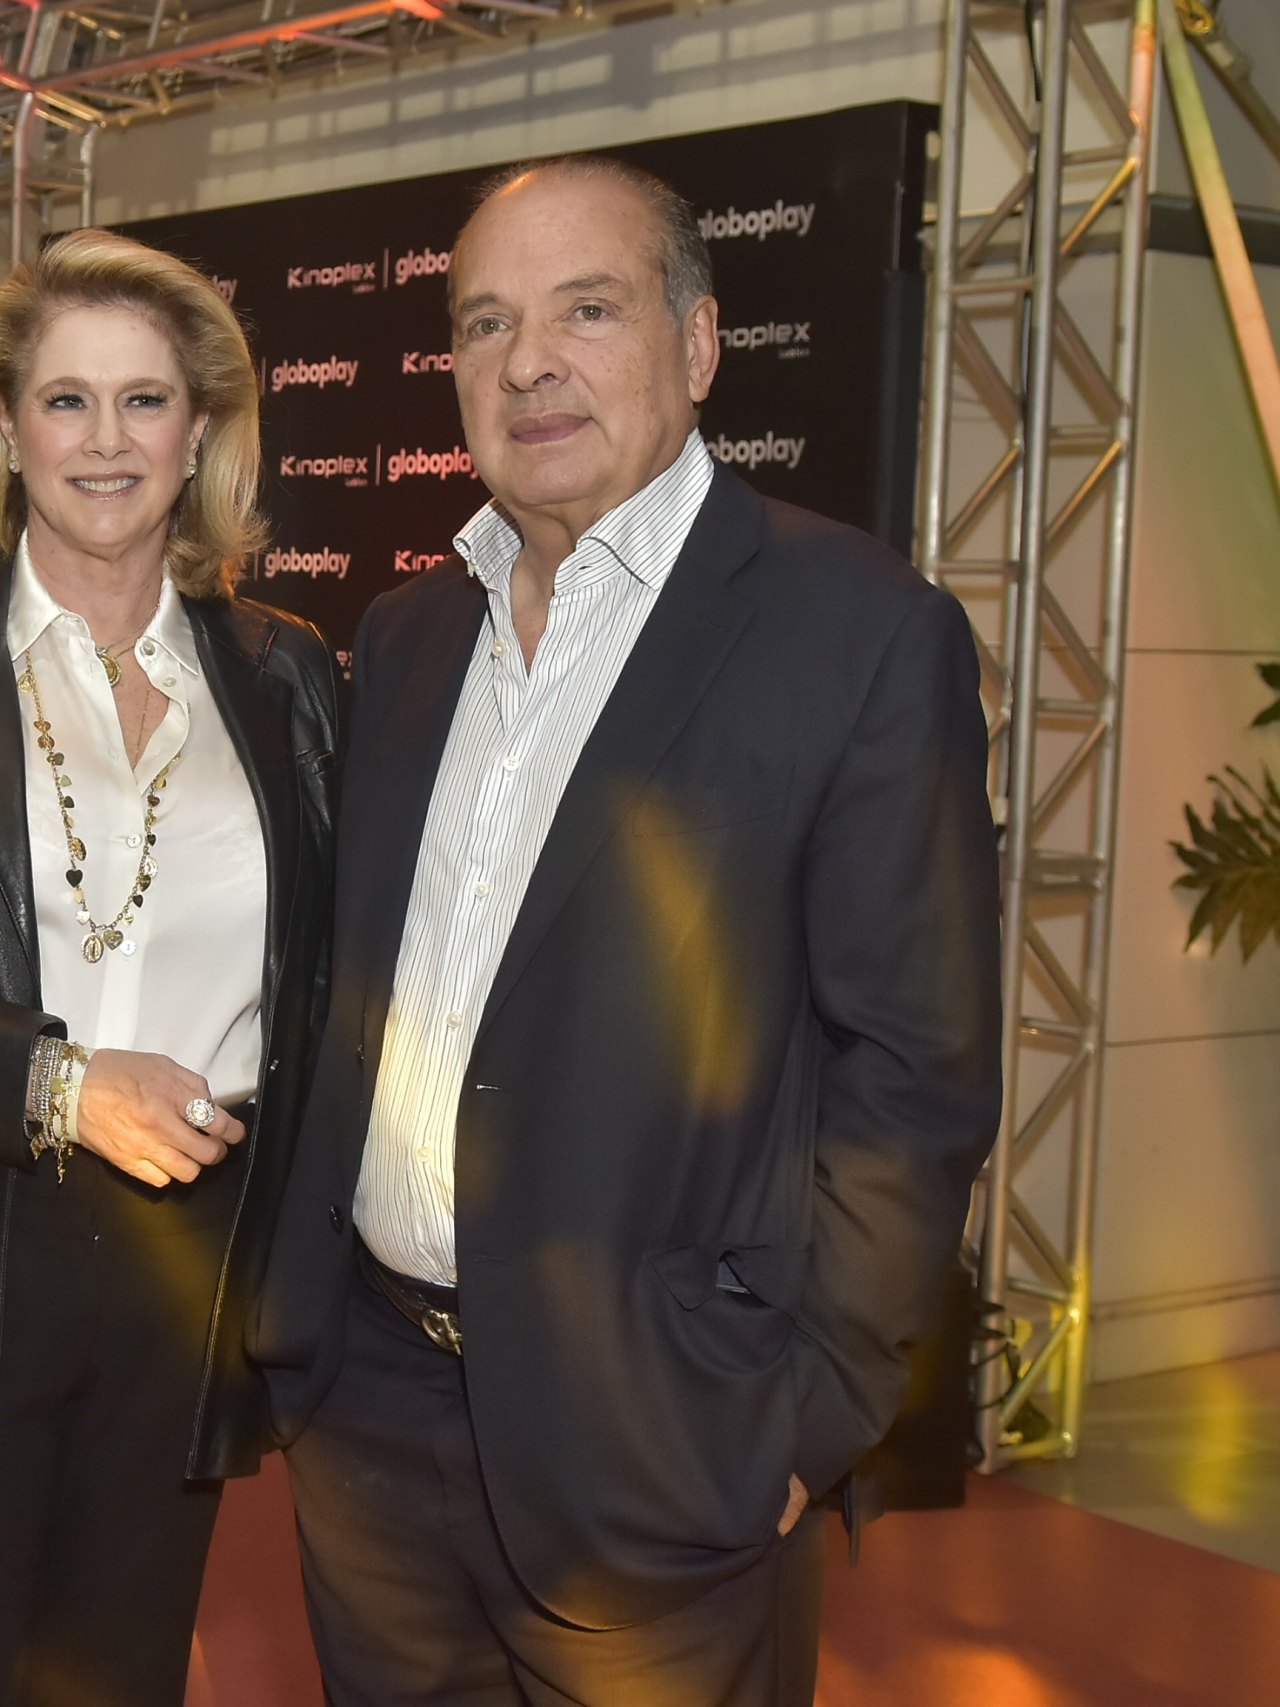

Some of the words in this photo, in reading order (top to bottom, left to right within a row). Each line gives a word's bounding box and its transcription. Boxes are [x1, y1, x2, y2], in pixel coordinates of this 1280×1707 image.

[287, 261, 376, 289] Kinoplex
[395, 247, 454, 285] globo
[272, 354, 358, 392] globoplay
[280, 454, 368, 479] Kinoplex
[265, 546, 351, 579] globoplay
